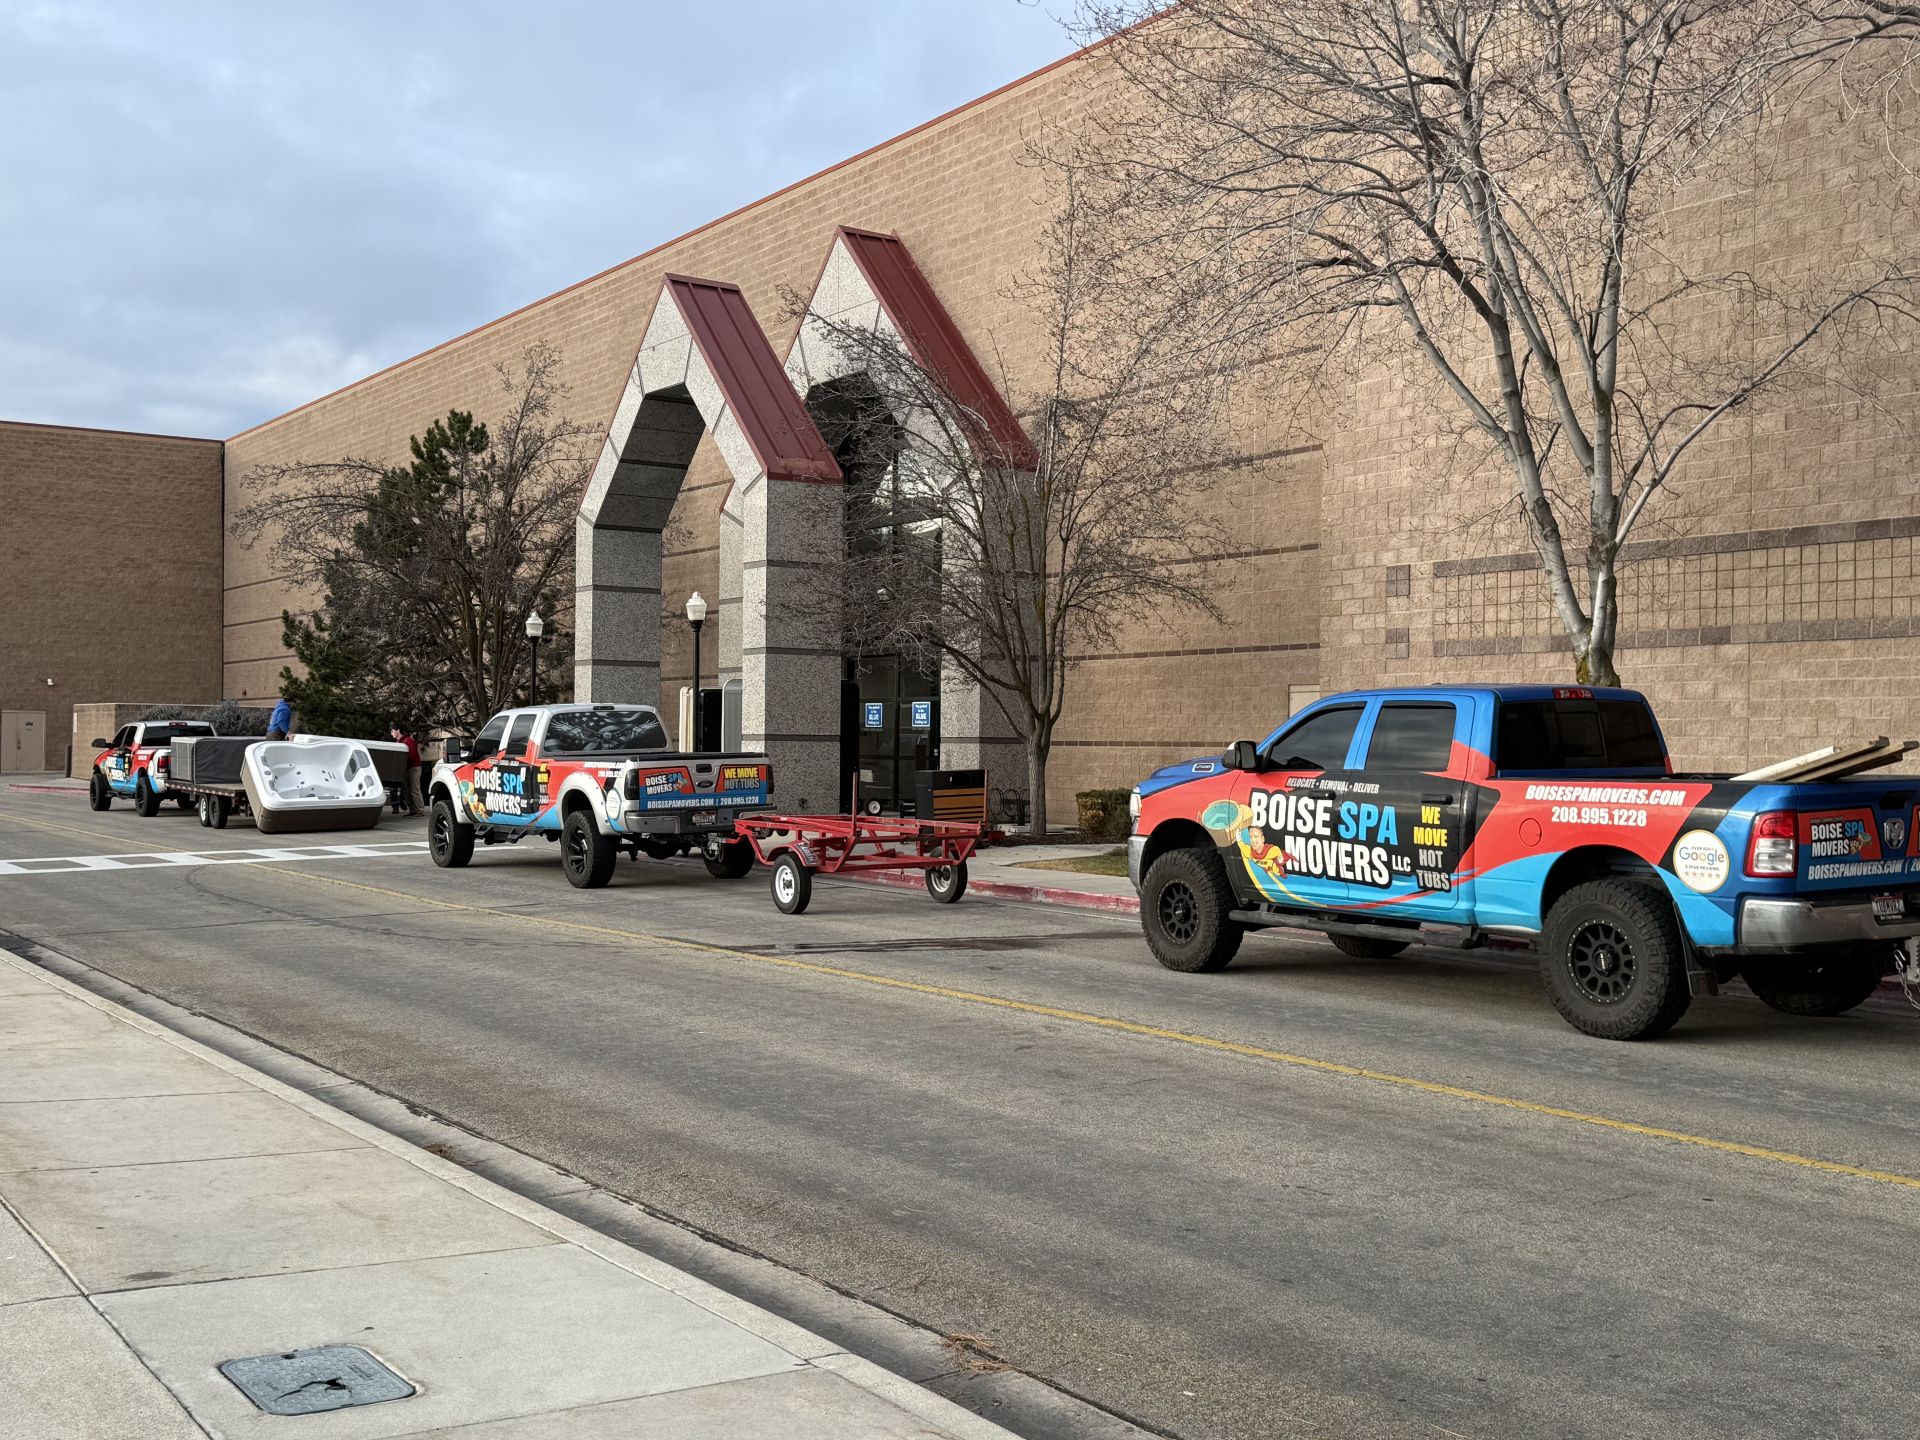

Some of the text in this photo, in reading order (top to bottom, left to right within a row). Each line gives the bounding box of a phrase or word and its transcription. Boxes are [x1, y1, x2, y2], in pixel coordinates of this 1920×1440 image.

[474, 767, 501, 791] BOISE
[503, 773, 523, 794] SPA
[646, 773, 682, 786] BOISE SPA
[724, 767, 758, 778] WE MOVE
[646, 783, 673, 795] MOVERS
[724, 778, 739, 790] HOT
[740, 777, 759, 789] TUBS
[1286, 777, 1380, 794] RELOCATE REMOVAL DELIVER
[486, 792, 521, 815] MOVERS
[647, 798, 714, 809] BOISESPAMOVERS.COM
[1526, 785, 1686, 806] BOISESPAMOVERS.COM
[1250, 791, 1399, 846] BOISE SPA
[1421, 805, 1441, 824] WE
[1551, 806, 1647, 827] 208.995.1228
[1413, 827, 1448, 847] MOVE
[1811, 821, 1865, 841] BOISE SPA
[1679, 846, 1725, 866] Google
[1811, 839, 1850, 857] MOVERS
[1284, 835, 1411, 885] MOVERS LLC
[1418, 849, 1443, 868] HOT
[1416, 869, 1450, 890] TUBS
[1808, 859, 1904, 880] BOISESPAMOVERS.COM
